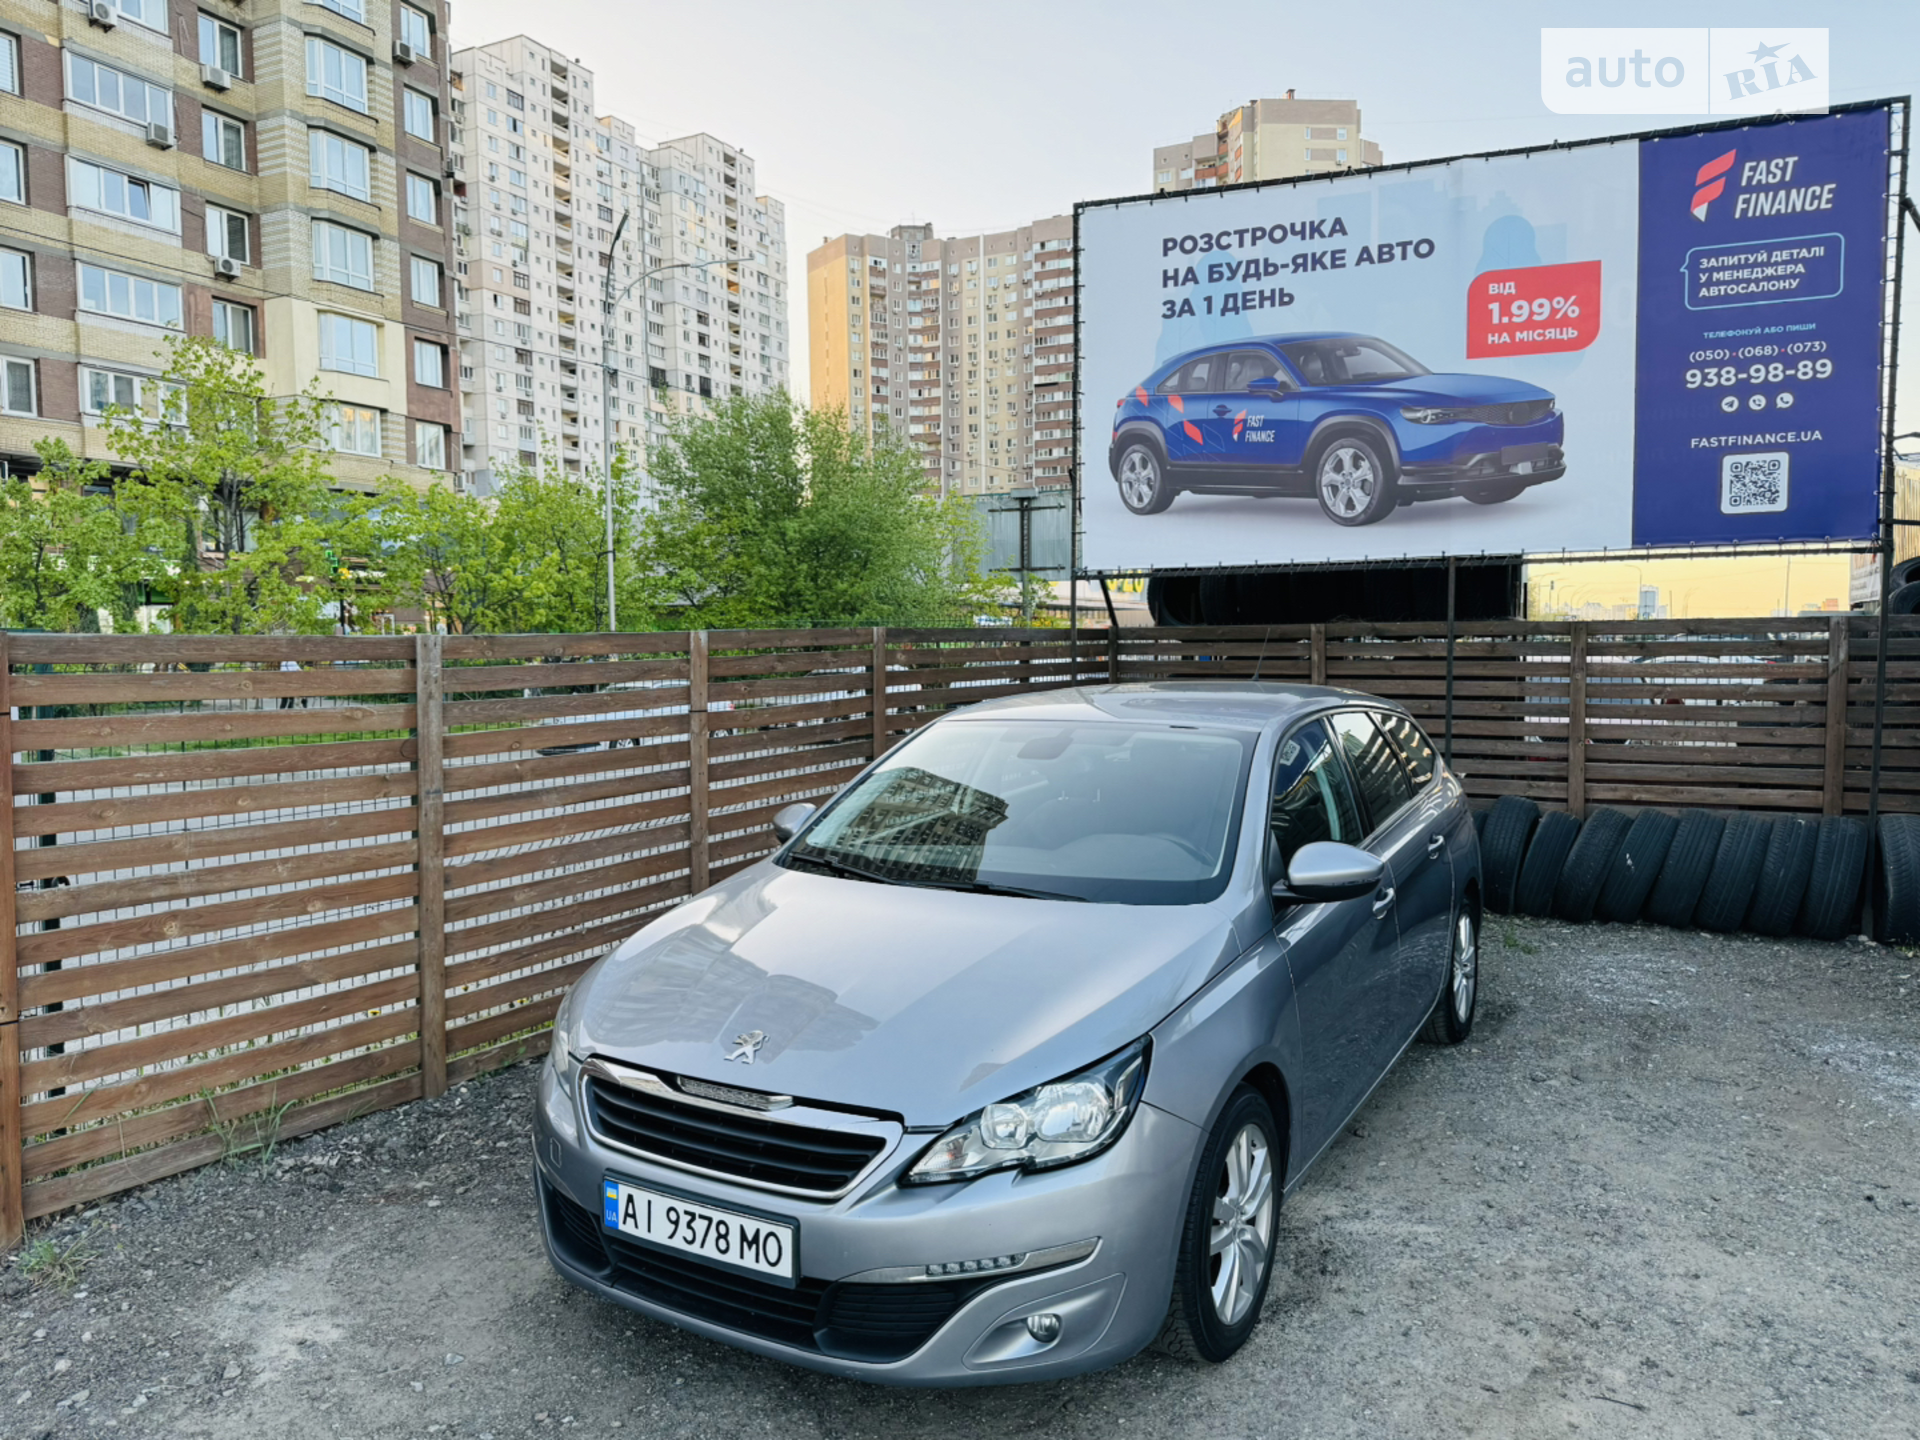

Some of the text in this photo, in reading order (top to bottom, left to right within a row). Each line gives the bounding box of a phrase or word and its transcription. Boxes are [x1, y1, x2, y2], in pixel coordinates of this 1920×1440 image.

[1740, 156, 1798, 186] FAST
[1734, 183, 1837, 219] FINANCE
[1162, 216, 1348, 257] РОЗСТРОЧКА
[1161, 238, 1435, 289] НА БУДЬ-ЯКЕ АВТО
[1699, 246, 1825, 269] ЗАПИТУЙ ДЕТАЛІ
[1699, 263, 1805, 284] У МЕНЕДЖЕРА
[1488, 281, 1516, 295] ВІД
[1698, 278, 1801, 298] АВТОСАЛОНУ
[1161, 287, 1295, 319] ЗА 1 ДЕНЬ
[1487, 295, 1580, 325] 1.99%
[1487, 327, 1578, 345] НА МІСЯЦЬ
[1703, 323, 1816, 339] ТЕЛЕФОНУЙ АБО ПИШИ
[1689, 341, 1827, 363] (050) (068) (073)
[1685, 358, 1833, 389] 938-98-89
[1247, 415, 1264, 427] FAST
[1245, 430, 1275, 442] FINANCE
[1691, 430, 1823, 449] FASTFINANCE.UA
[606, 1209, 617, 1223] UA
[622, 1193, 783, 1267] AI 9378 MO
